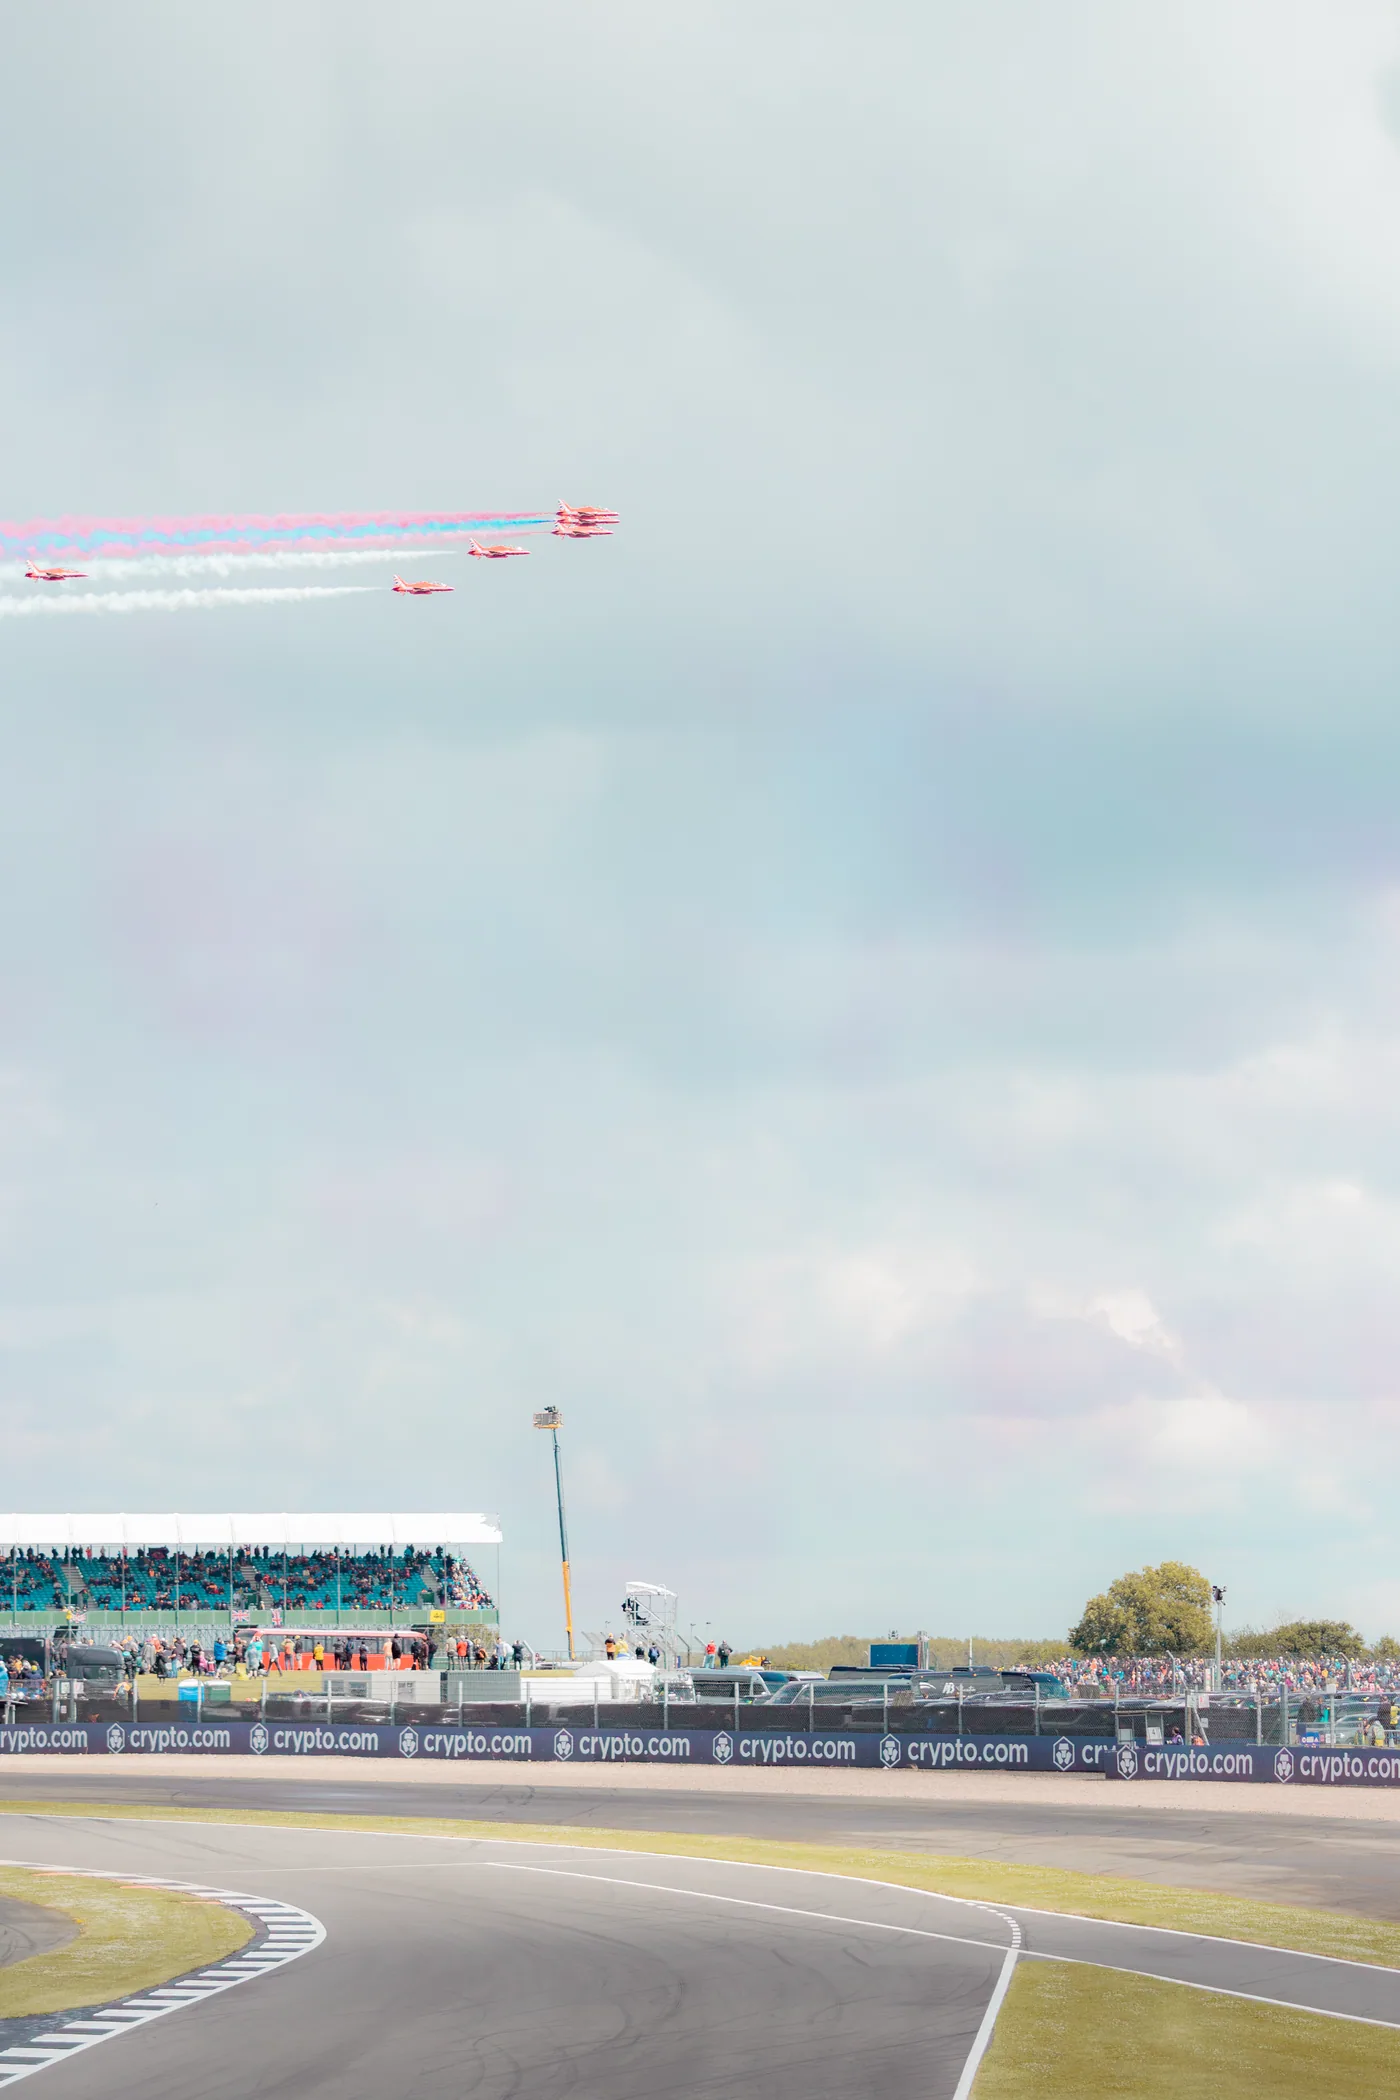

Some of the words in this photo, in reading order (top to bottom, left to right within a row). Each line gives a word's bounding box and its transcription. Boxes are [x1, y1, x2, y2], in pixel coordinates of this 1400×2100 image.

[0, 1727, 87, 1752] rypto.com
[131, 1727, 230, 1751] crypto.com
[274, 1728, 378, 1753] crypto.com
[424, 1731, 531, 1756] crypto.com
[580, 1733, 689, 1760] crypto.com
[740, 1736, 855, 1763] crypto.com
[908, 1739, 1027, 1766] crypto.com
[1145, 1750, 1252, 1777] crypto.com
